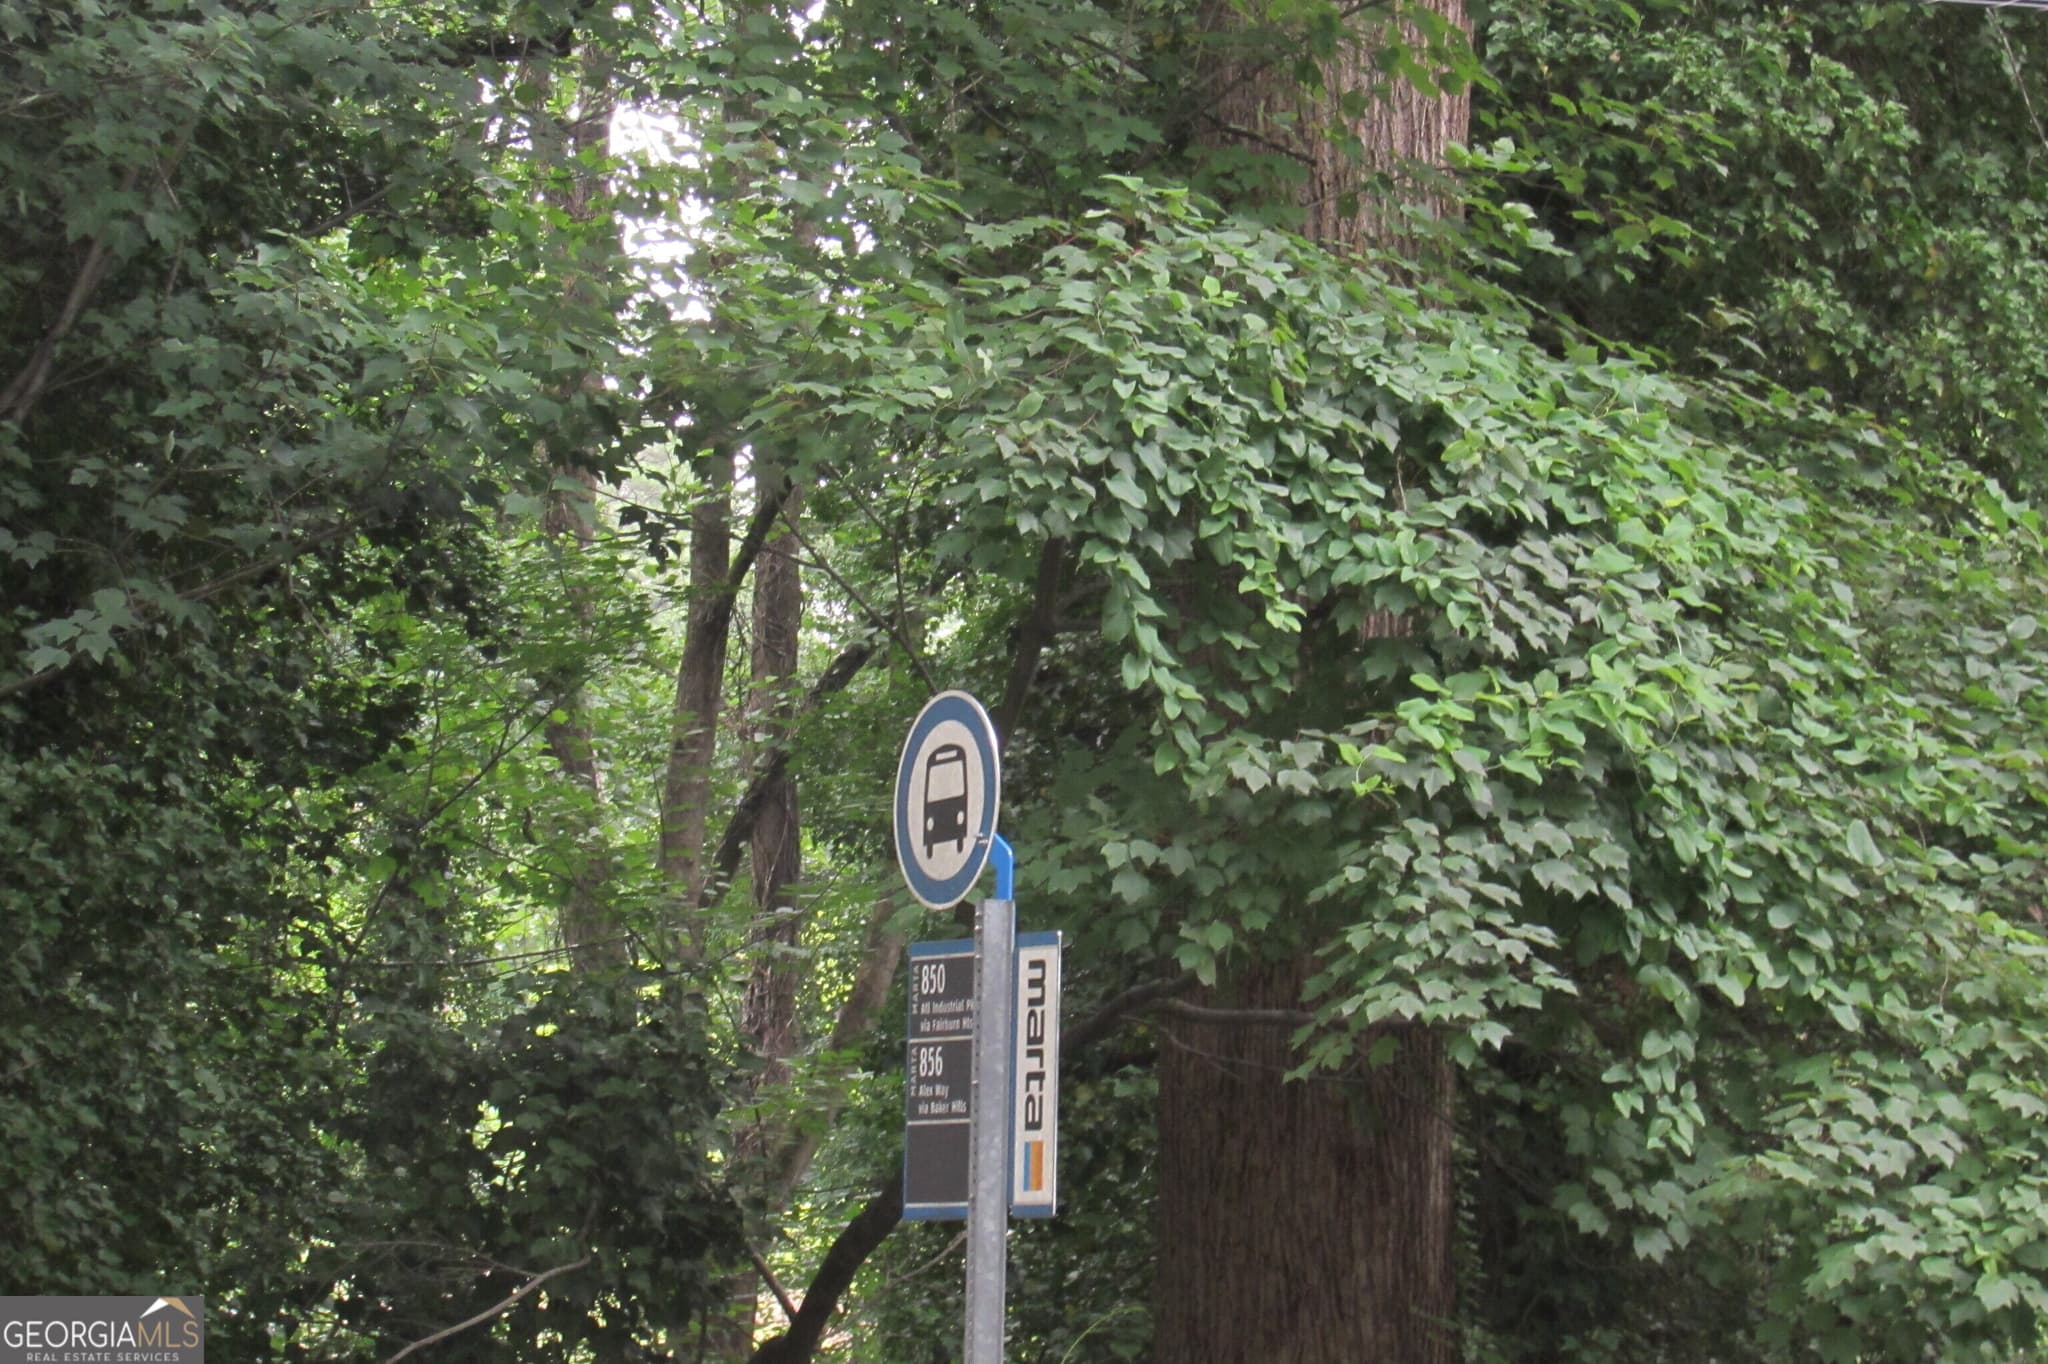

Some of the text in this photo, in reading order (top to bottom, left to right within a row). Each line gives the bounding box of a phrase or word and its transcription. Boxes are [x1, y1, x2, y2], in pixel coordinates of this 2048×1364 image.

[921, 963, 945, 994] 850
[932, 999, 965, 1014] Industrial
[920, 1018, 931, 1032] via
[1024, 959, 1047, 1131] marta
[919, 1046, 943, 1077] 856
[935, 1084, 950, 1099] Way
[918, 1102, 929, 1115] via
